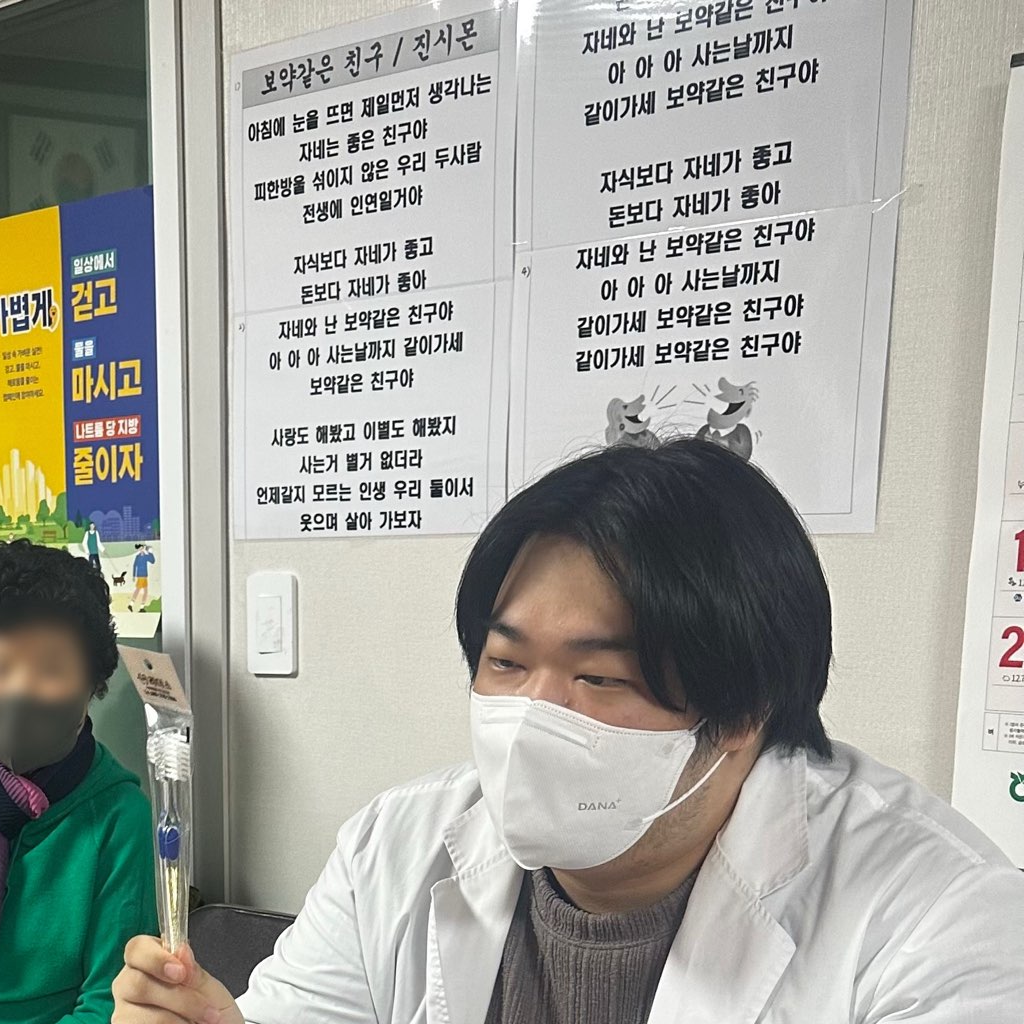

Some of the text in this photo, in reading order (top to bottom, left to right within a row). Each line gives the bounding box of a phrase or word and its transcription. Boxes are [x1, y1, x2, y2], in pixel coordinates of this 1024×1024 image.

[582, 22, 636, 54] 자네와
[647, 17, 665, 41] 난
[674, 0, 753, 34] 보약같은
[261, 54, 334, 95] 보약같은
[344, 42, 383, 78] 친구
[412, 18, 477, 62] 진시몬
[608, 24, 793, 84] 아 아 아 사는날까지
[248, 73, 491, 142] 아침에 눈을 뜨면 제일먼저 생각나는
[584, 58, 819, 126] 같이가세 보약같은 친구야
[299, 118, 428, 162] 자네는 좋은 친구야
[254, 141, 482, 201] 피한방울 섞이지 않은 우리 두사람
[600, 141, 792, 193] 자식보다 자네가 좋고
[303, 185, 423, 224] 전생에 인연일거야
[609, 181, 781, 228] 돈보다 자네가 좋아
[73, 252, 115, 275] 일상에서
[294, 236, 433, 274] 자식보다 자네가 좋고
[576, 218, 815, 270] 자네와 난 보약같은 친구야
[71, 278, 118, 322] 걷고
[301, 269, 426, 305] 돈보다 자네가 좋아
[601, 259, 780, 301] 아 아 아 사는날까지
[278, 301, 453, 340] 자네와 난 보약같은 친구야
[577, 294, 804, 338] 같이가세 보약같은 친구야
[269, 331, 463, 370] 아 아 아 사는날까지 같이가세
[576, 331, 801, 372] 같이가세 보약같은 친구야
[72, 359, 142, 403] 마시고
[310, 368, 414, 395] 보약같은 친구야
[76, 418, 139, 439] 나트륨 당 지방
[271, 416, 456, 447] 사랑도 해봤고 이별도 해봤지
[73, 443, 144, 486] 줄이자
[299, 449, 423, 474] 사는거 별거 없더라
[313, 483, 351, 502] 모르는
[359, 481, 385, 501] 인생
[394, 480, 421, 499] 우리
[430, 477, 473, 498] 둘이서
[300, 510, 422, 532] 웃으며 살아 가보자
